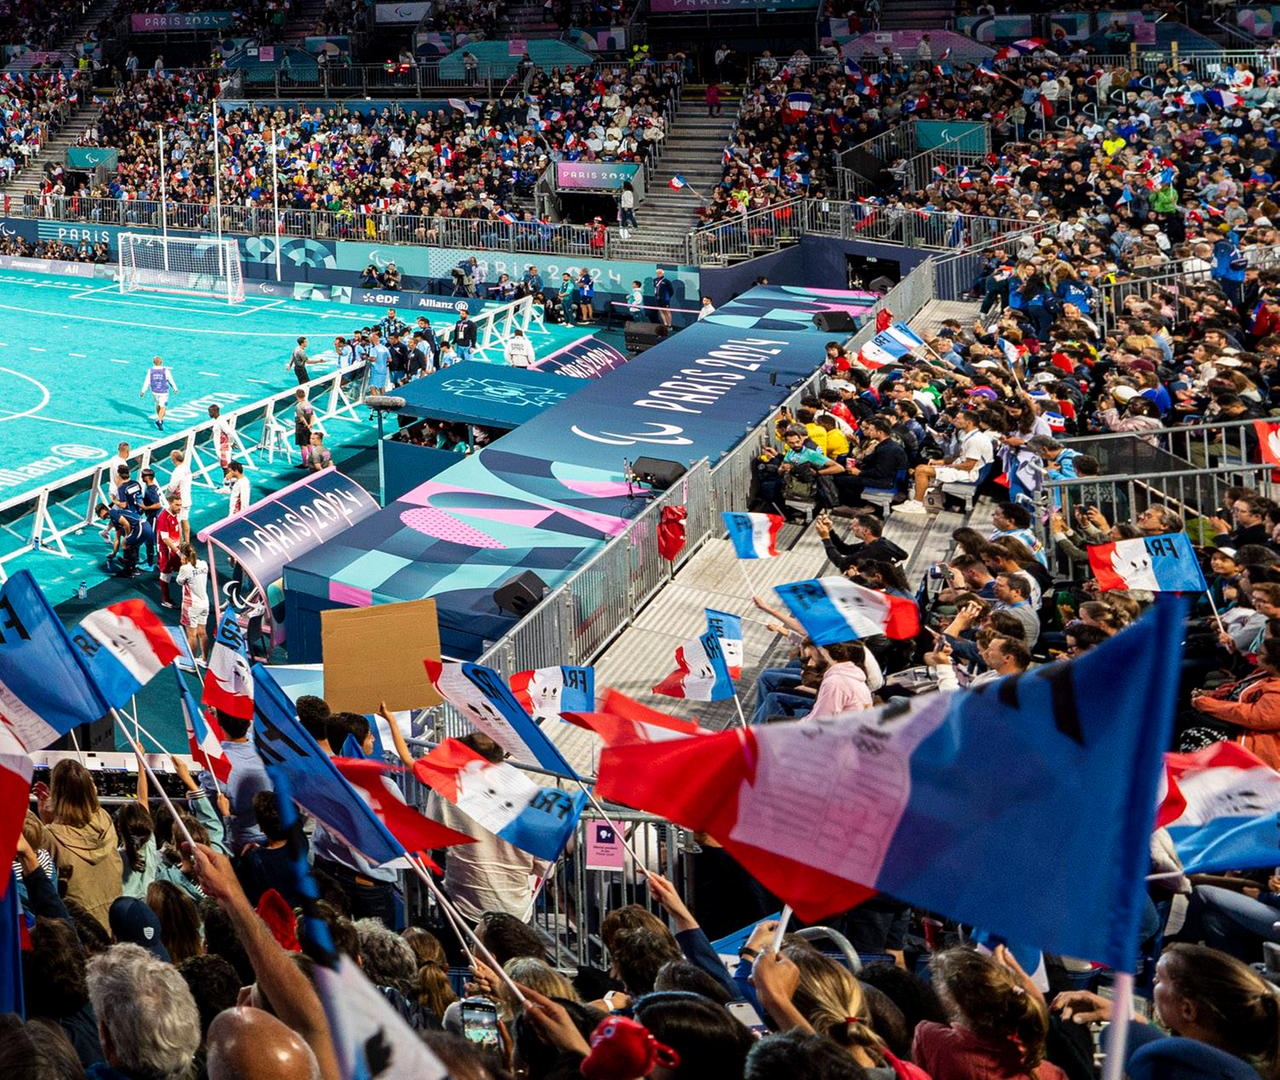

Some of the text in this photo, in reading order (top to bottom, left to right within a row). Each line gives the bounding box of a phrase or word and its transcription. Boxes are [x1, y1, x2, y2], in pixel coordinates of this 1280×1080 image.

[145, 17, 180, 26] PARIS
[562, 170, 632, 180] PARIS 2024
[419, 298, 454, 309] Allianz
[695, 338, 790, 372] 2024
[303, 486, 364, 538] 2024
